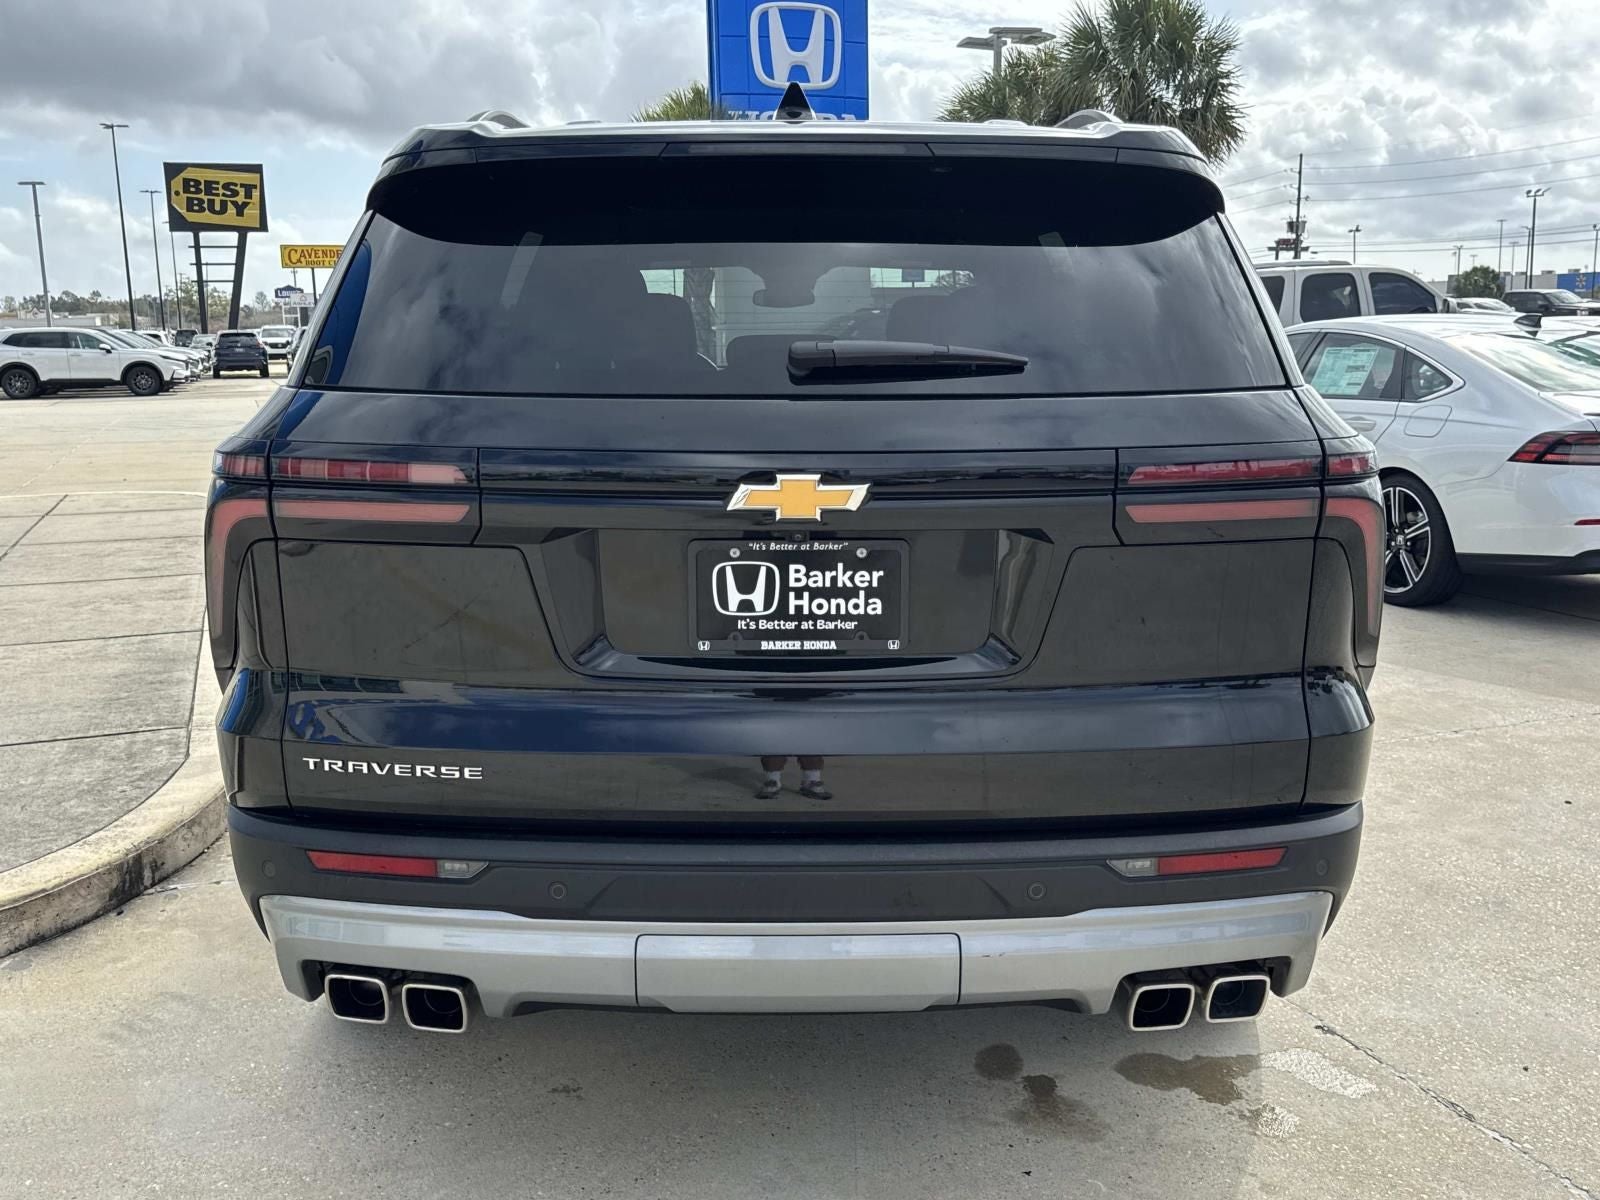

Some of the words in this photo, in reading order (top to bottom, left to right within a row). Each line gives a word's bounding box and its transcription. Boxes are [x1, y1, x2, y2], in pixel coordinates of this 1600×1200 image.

[182, 177, 258, 200] BEST
[185, 196, 252, 217] BUY
[769, 542, 798, 551] Better
[800, 543, 810, 551] at
[788, 562, 884, 588] Barker
[788, 590, 882, 615] Honda
[737, 618, 757, 630] It's
[758, 619, 798, 630] Better
[800, 619, 815, 630] at
[816, 619, 858, 630] Barker
[760, 641, 801, 650] BARKER
[803, 641, 837, 650] HONDA
[302, 757, 483, 780] TRAVERSE
